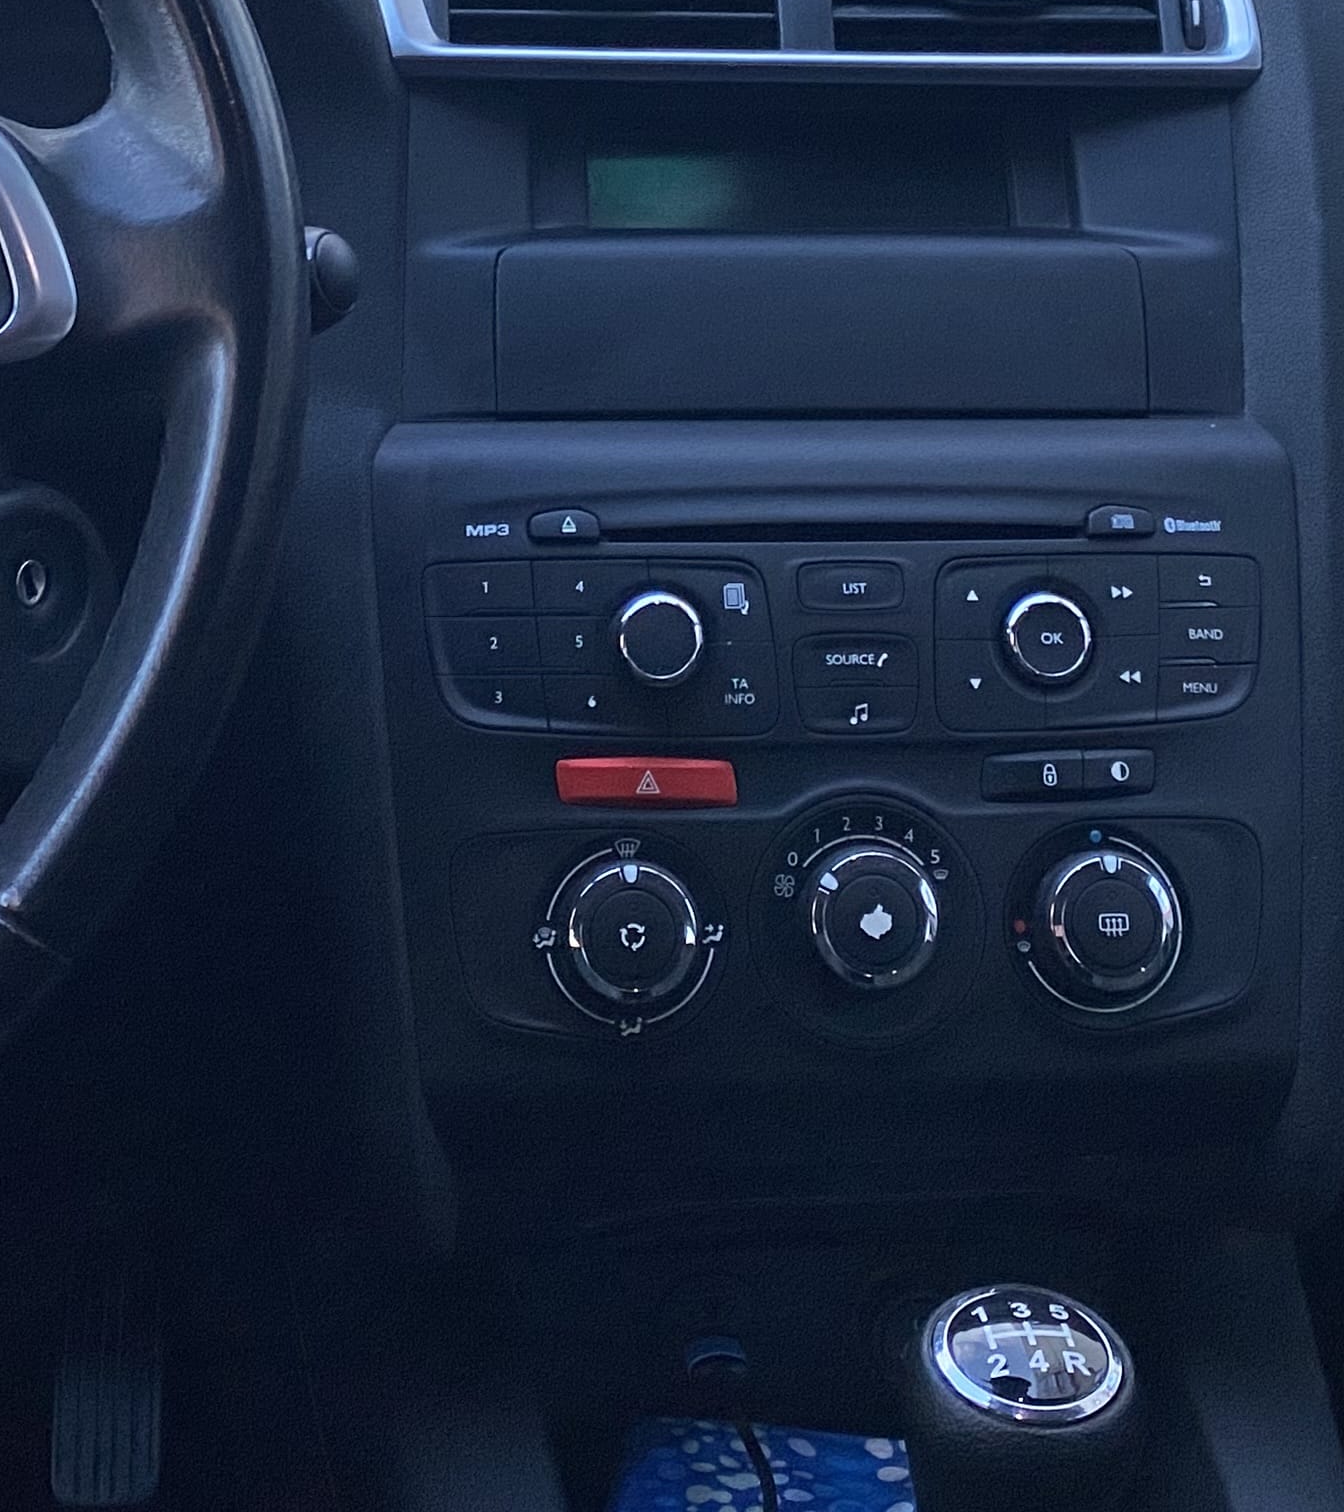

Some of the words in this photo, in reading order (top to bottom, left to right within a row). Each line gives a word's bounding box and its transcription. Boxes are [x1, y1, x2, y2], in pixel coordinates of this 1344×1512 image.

[465, 523, 510, 538] MP3
[482, 581, 490, 593] 1
[575, 580, 585, 593] 4
[842, 581, 868, 595] LIST
[575, 634, 584, 648] 5
[1039, 632, 1064, 646] OK
[1187, 627, 1224, 641] BAND
[489, 636, 499, 651] 2
[825, 653, 876, 666] SOURCE
[731, 677, 749, 689] TA
[1182, 681, 1219, 695] MENU
[494, 690, 503, 704] 3
[587, 694, 598, 708] 6
[724, 692, 756, 706] INFO
[813, 827, 821, 844] 1
[841, 816, 852, 832] 2
[874, 815, 884, 831] 3
[903, 828, 914, 843] 4
[930, 848, 941, 865] 5
[970, 1305, 989, 1323] 1
[1009, 1301, 1032, 1319] 3
[1048, 1303, 1070, 1321] 5
[987, 1353, 1010, 1379] 2
[1028, 1349, 1050, 1373] 4
[1062, 1349, 1092, 1376] R
